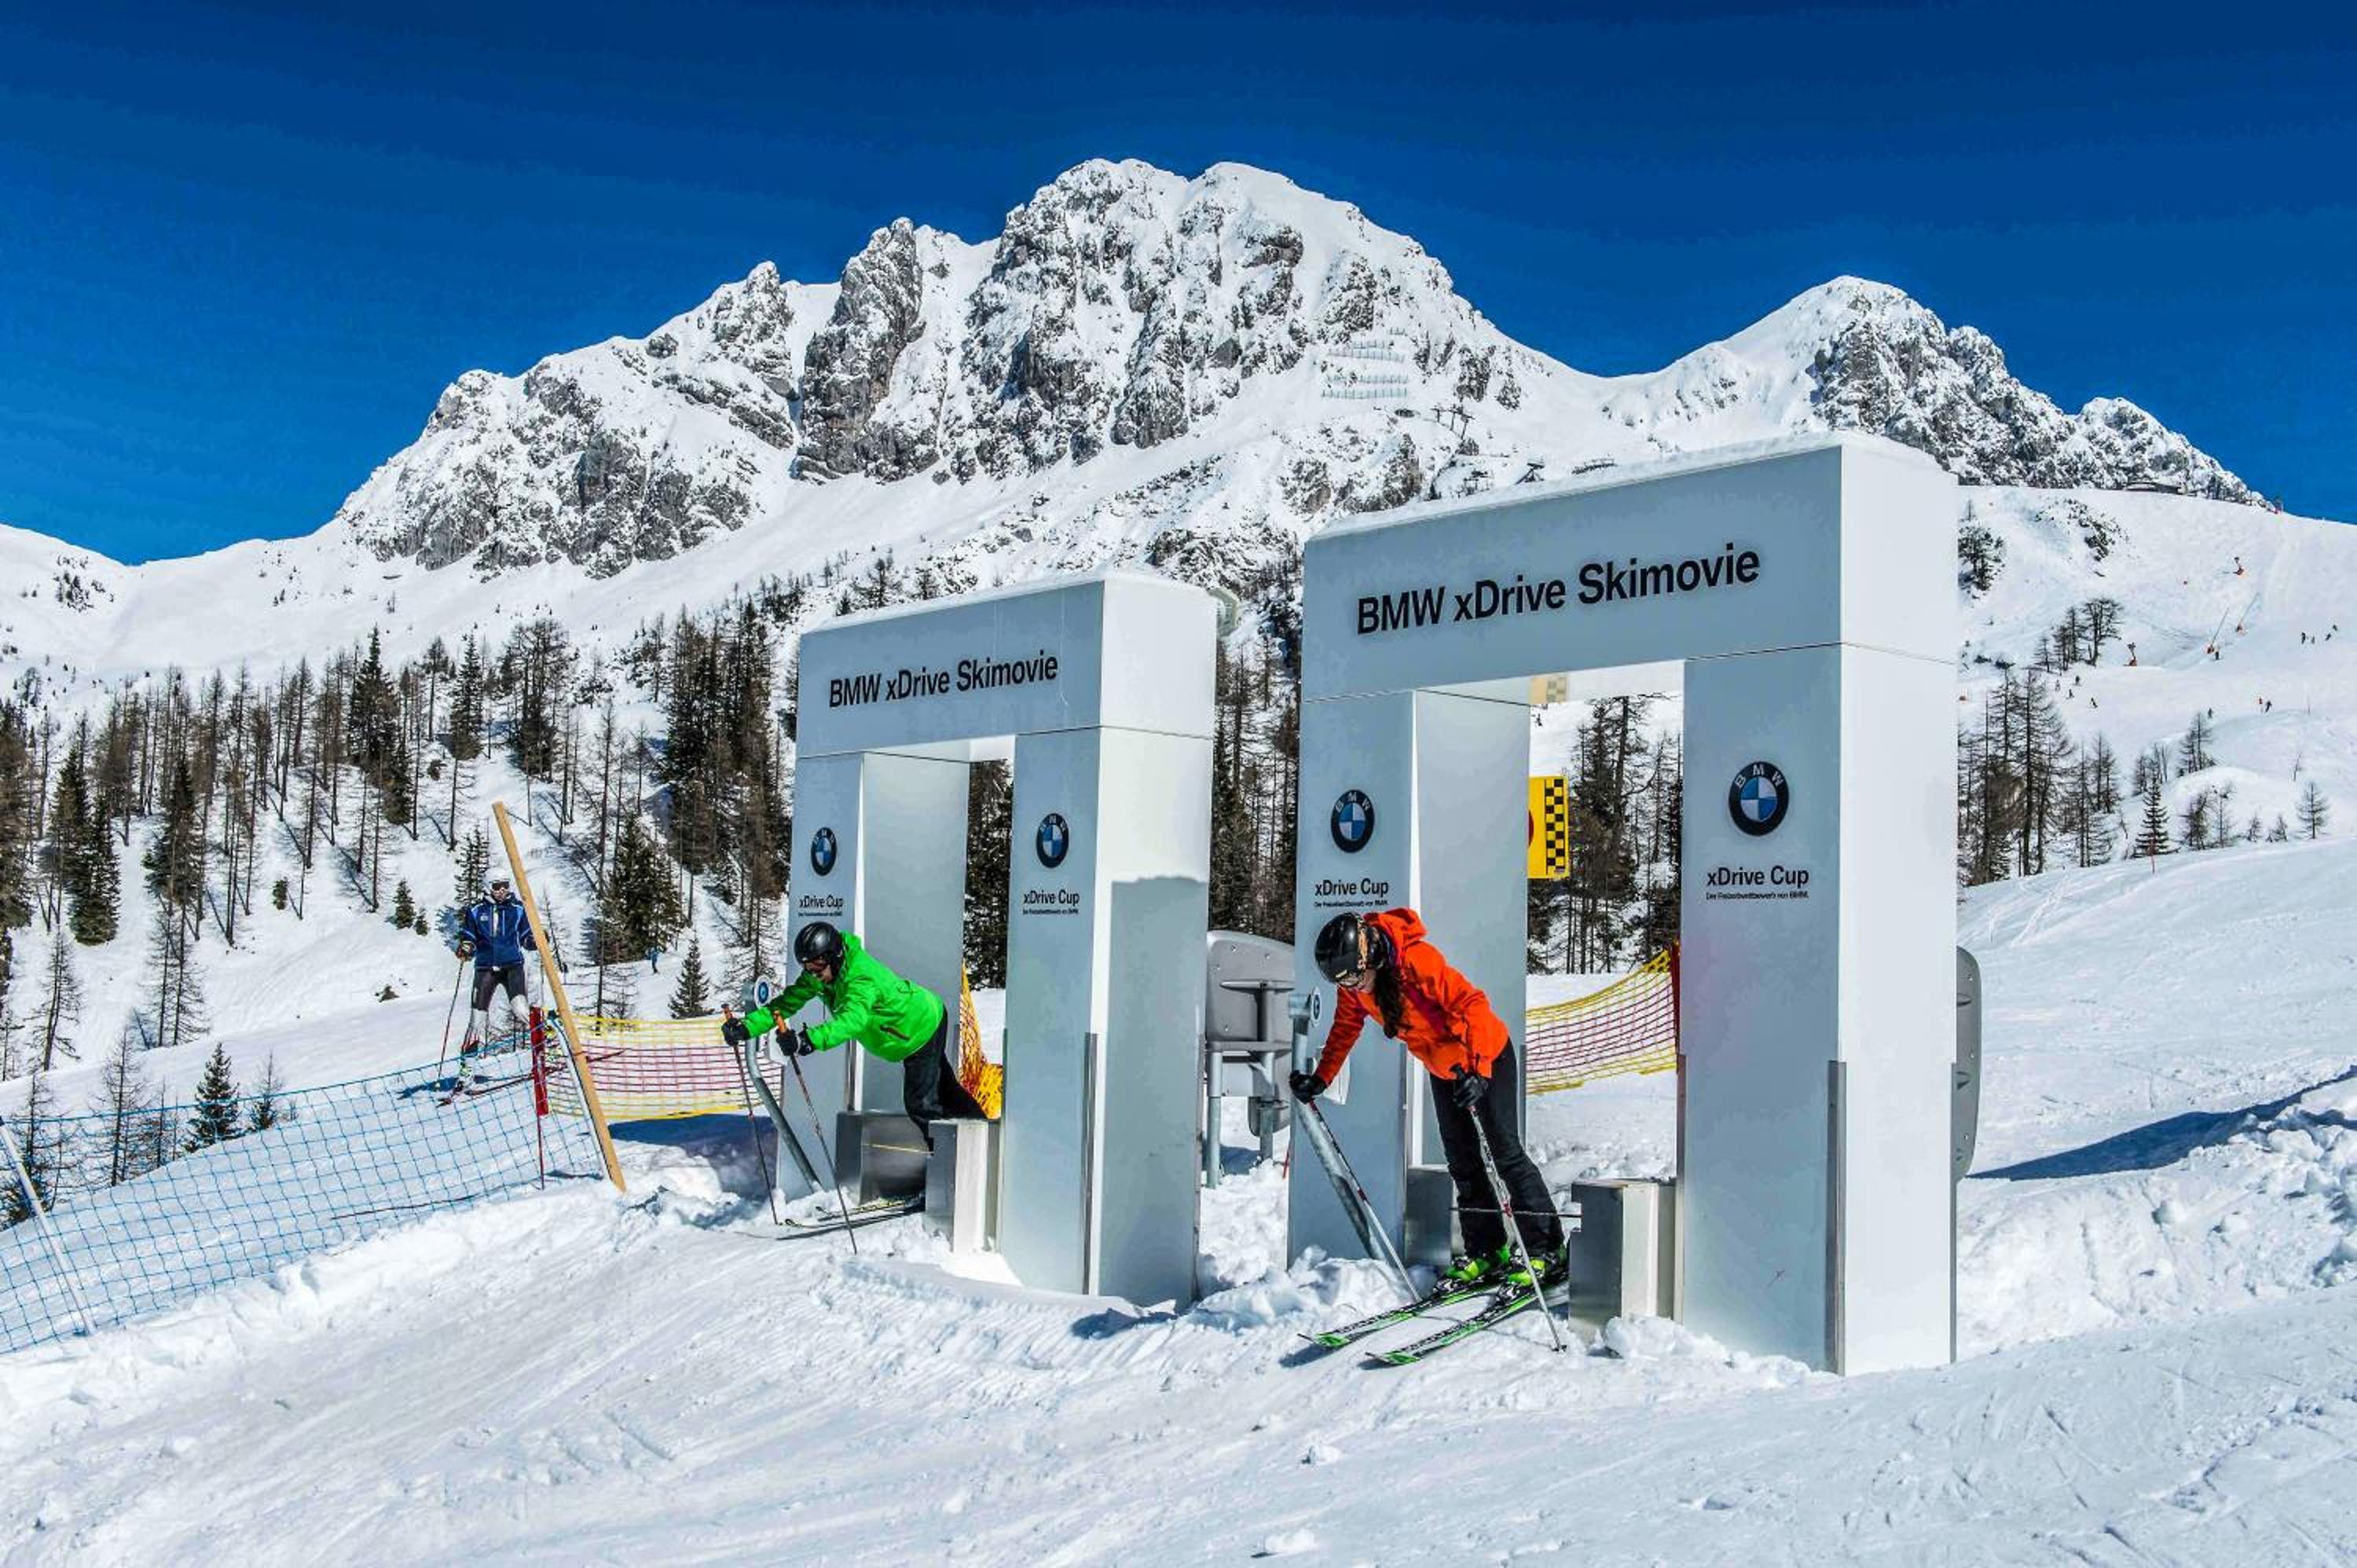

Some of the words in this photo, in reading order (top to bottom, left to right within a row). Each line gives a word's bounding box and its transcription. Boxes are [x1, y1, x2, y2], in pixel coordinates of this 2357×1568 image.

[1357, 586, 1446, 635] BMW
[1453, 574, 1566, 621] xDrive
[1578, 542, 1761, 604] Skimovie
[829, 673, 882, 707] BMW
[885, 667, 951, 700] xDrive
[956, 650, 1058, 691] Skimovie
[1314, 879, 1357, 896] xDrive
[1360, 877, 1389, 898] Cup
[1707, 866, 1765, 886] xDrive
[1770, 865, 1809, 889] Cup
[826, 894, 843, 910] Cup
[1023, 889, 1056, 904] xDrive
[1058, 888, 1080, 907] Cup
